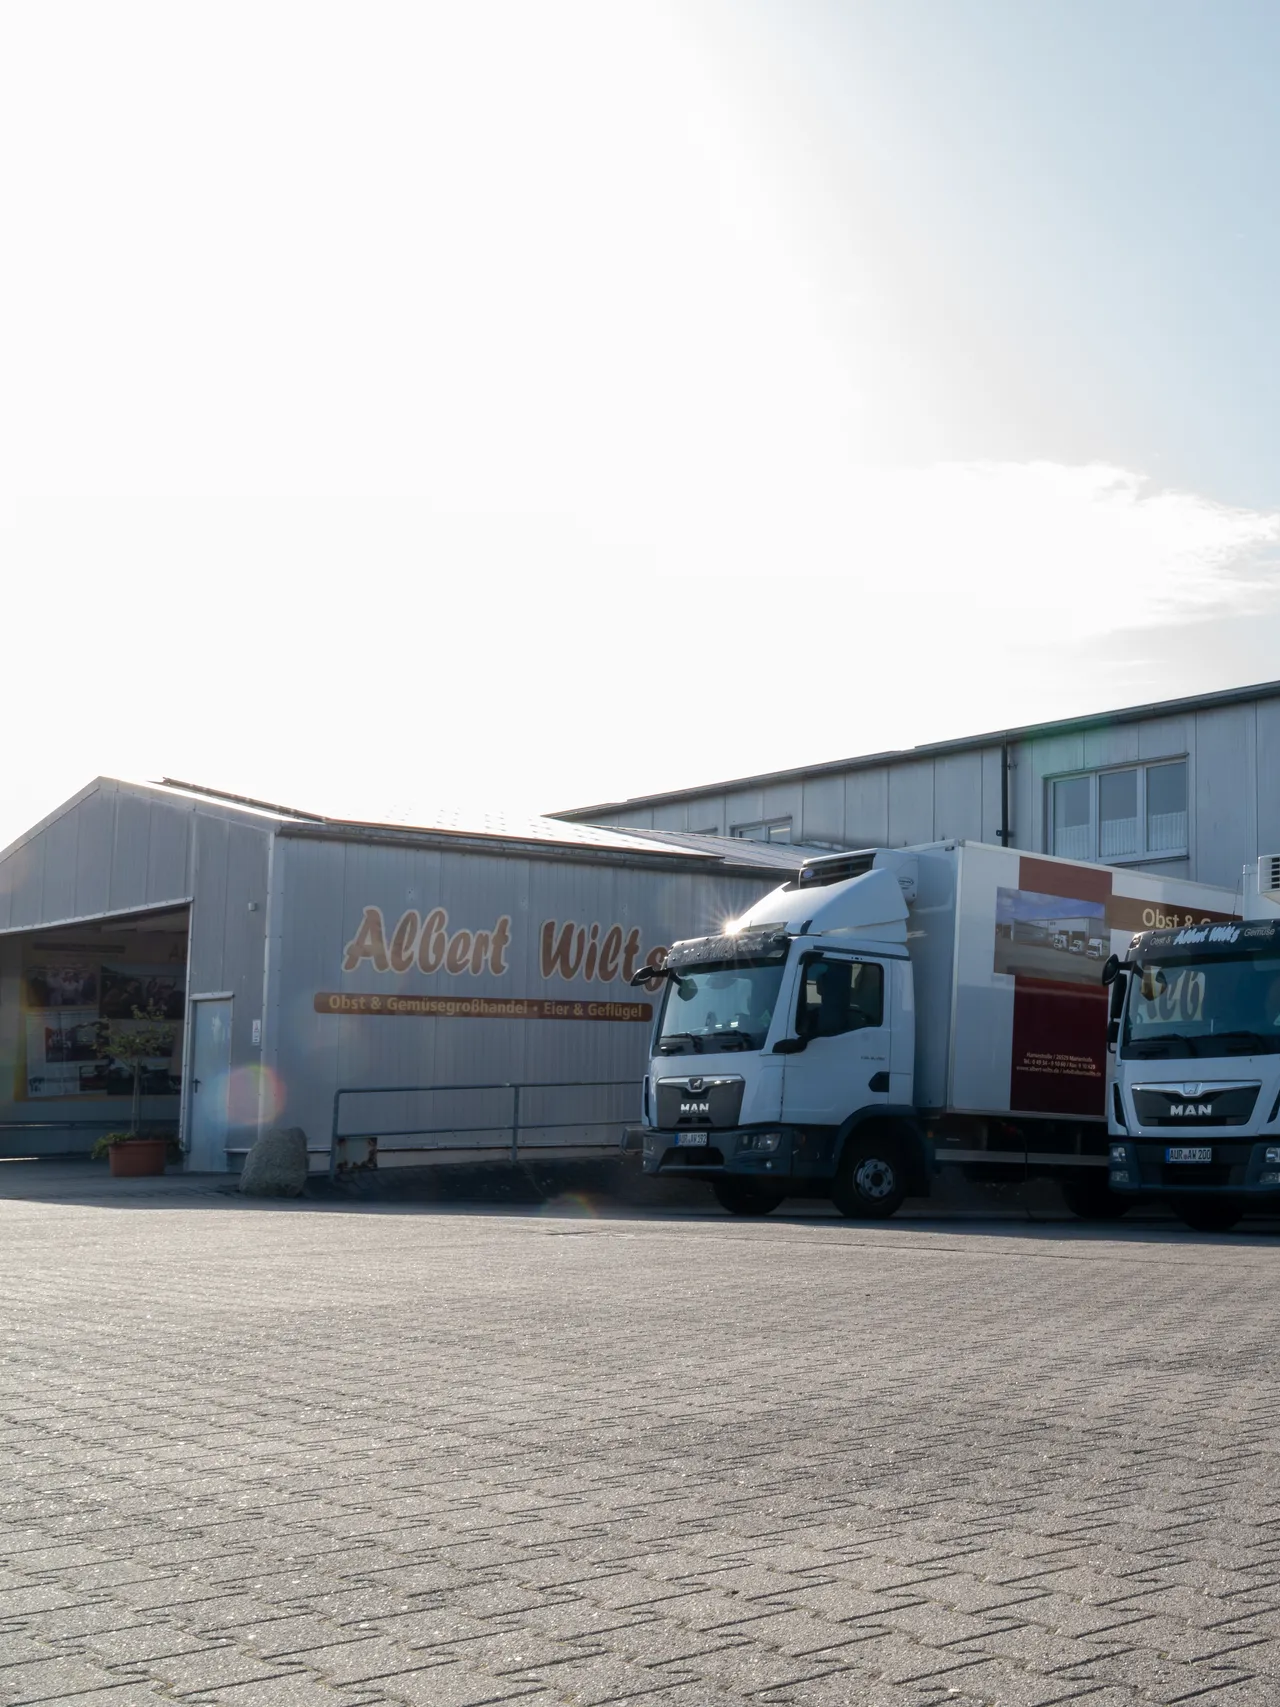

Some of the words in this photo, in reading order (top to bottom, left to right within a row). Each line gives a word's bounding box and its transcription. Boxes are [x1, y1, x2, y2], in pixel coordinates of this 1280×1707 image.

[1142, 908, 1180, 928] Obst
[341, 905, 513, 977] Albert
[329, 995, 366, 1010] Obst
[371, 996, 383, 1010] &
[387, 997, 528, 1016] Gemüsegroßhandel
[544, 1001, 570, 1016] Eier
[573, 1003, 584, 1016] &
[588, 1003, 642, 1020] Geflügel
[680, 1103, 709, 1112] MAN
[1170, 1105, 1212, 1116] MAN
[1170, 1149, 1183, 1160] AUR
